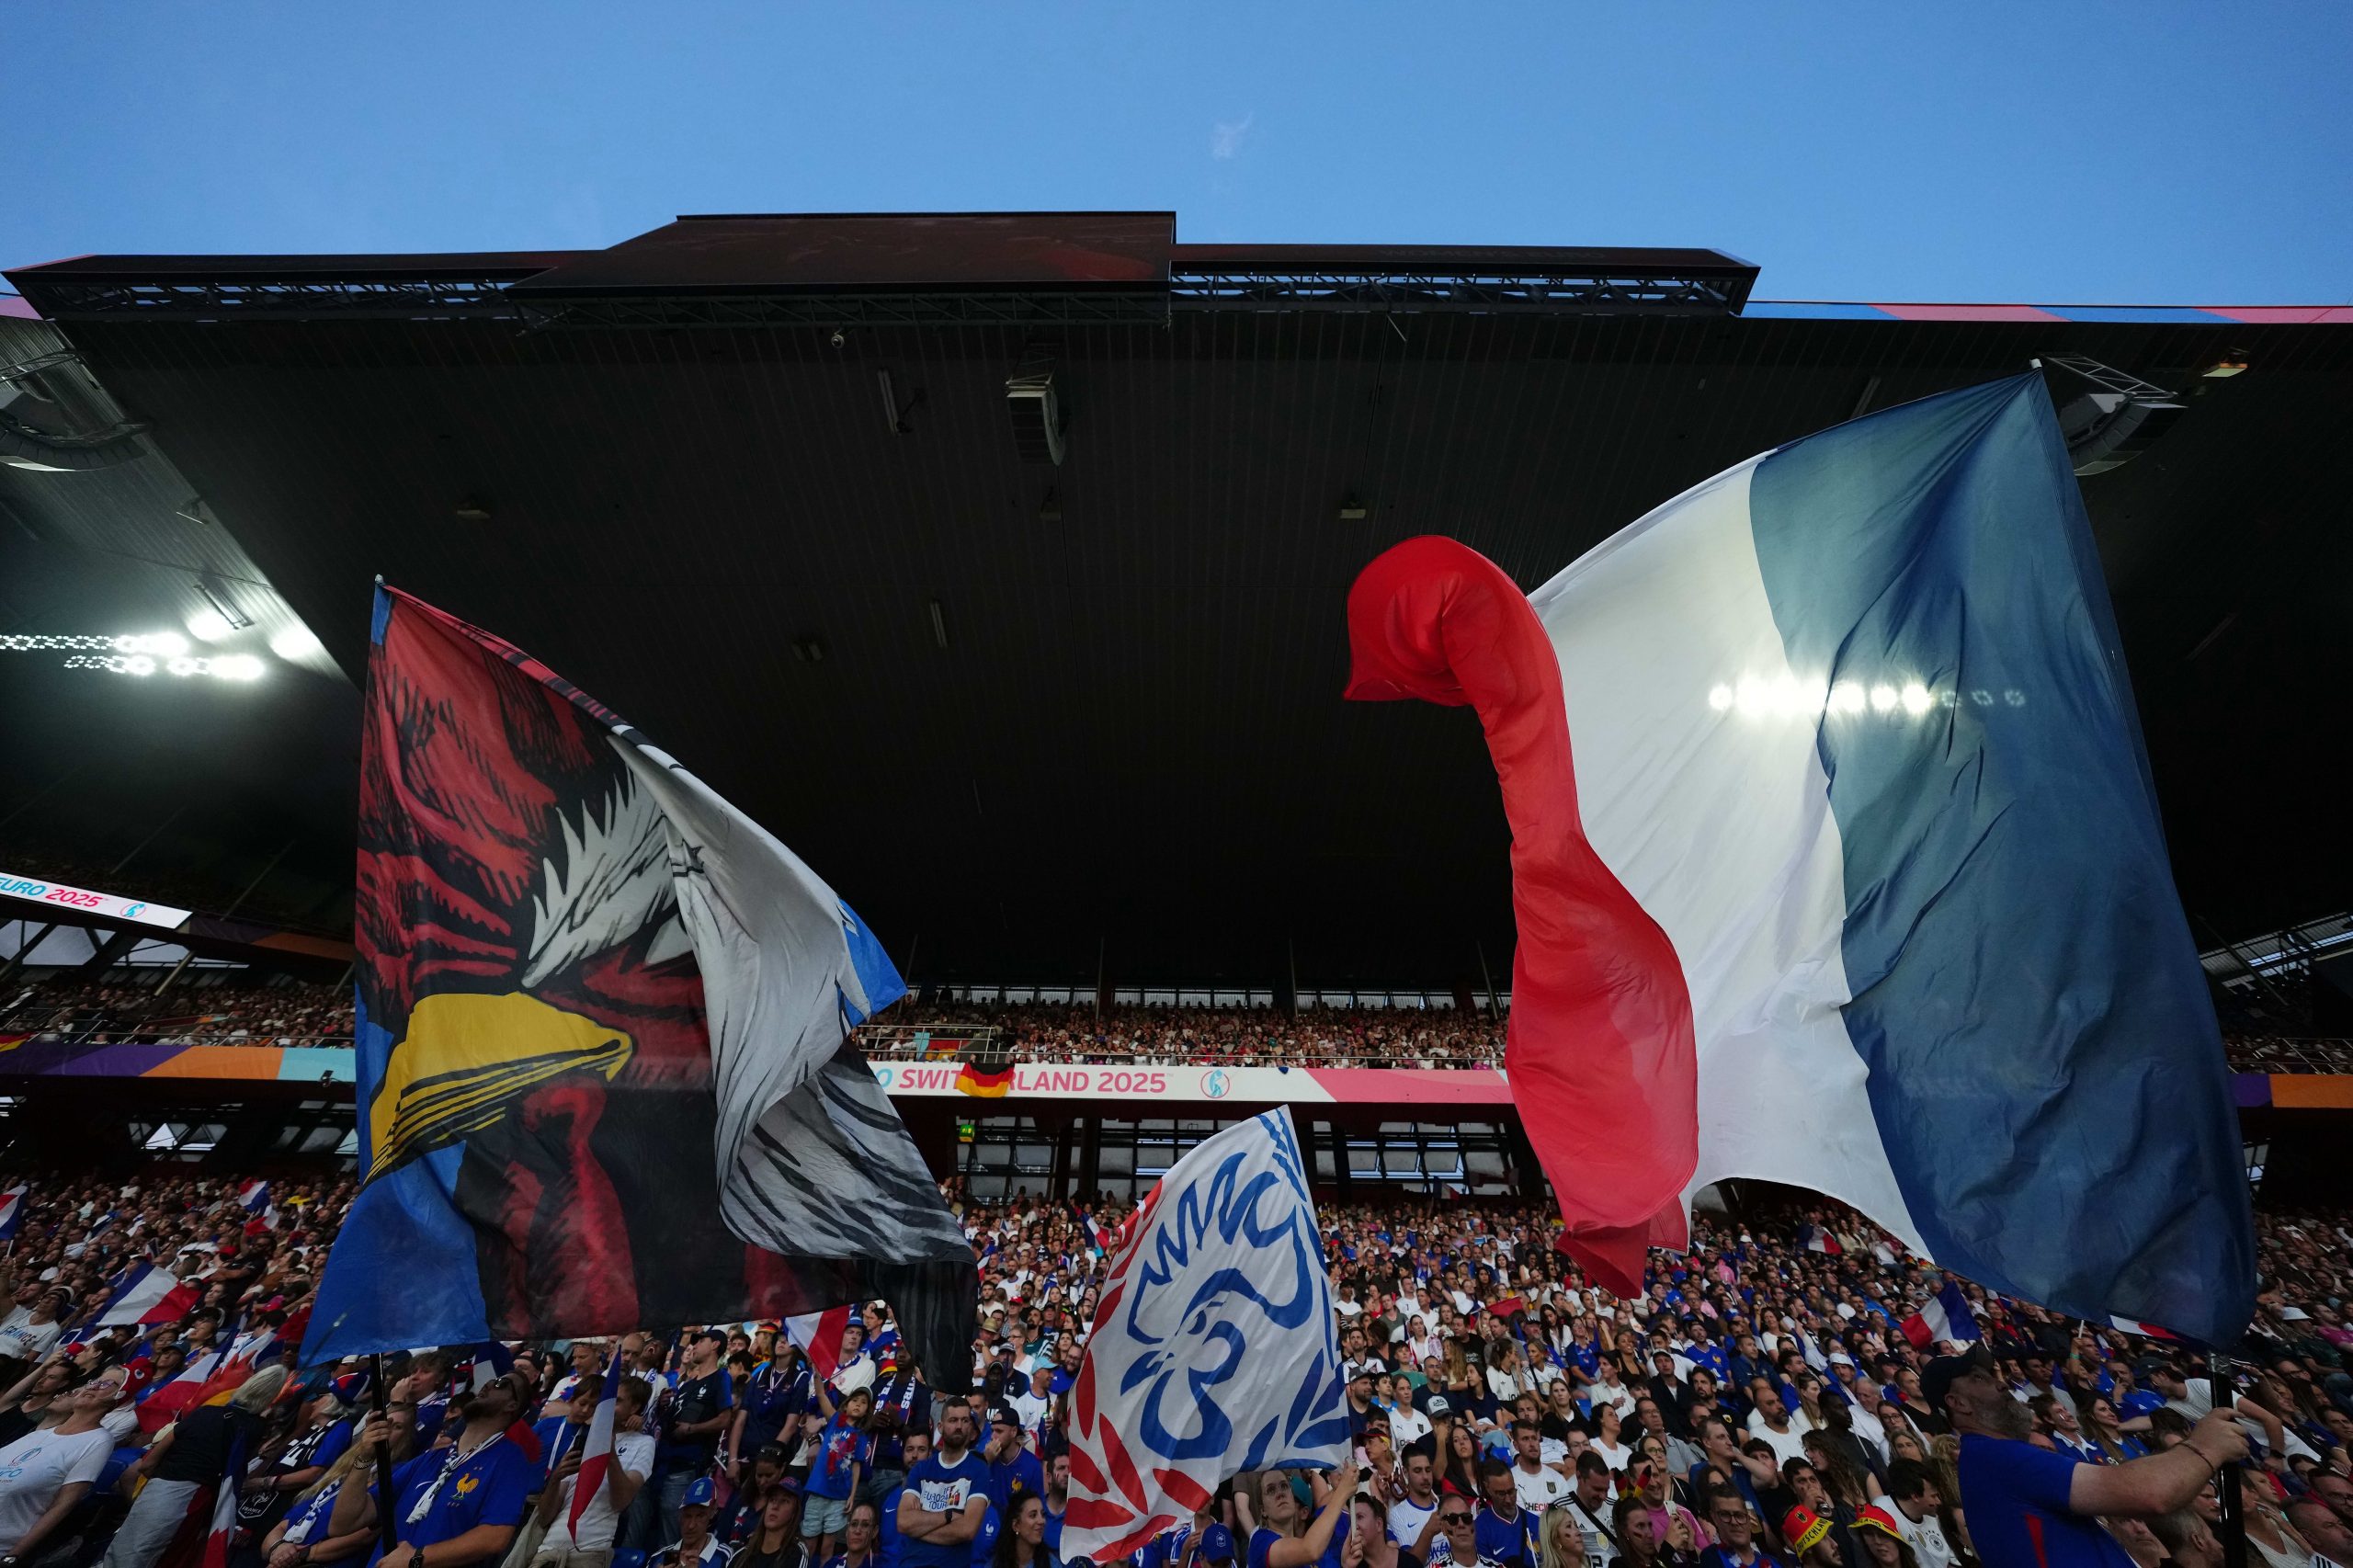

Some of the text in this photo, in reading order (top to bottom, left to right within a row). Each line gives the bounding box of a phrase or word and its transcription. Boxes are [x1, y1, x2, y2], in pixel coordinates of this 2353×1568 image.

[45, 889, 104, 908] 2025
[898, 1068, 1090, 1093] SWITLAND
[1097, 1072, 1166, 1094] 2025
